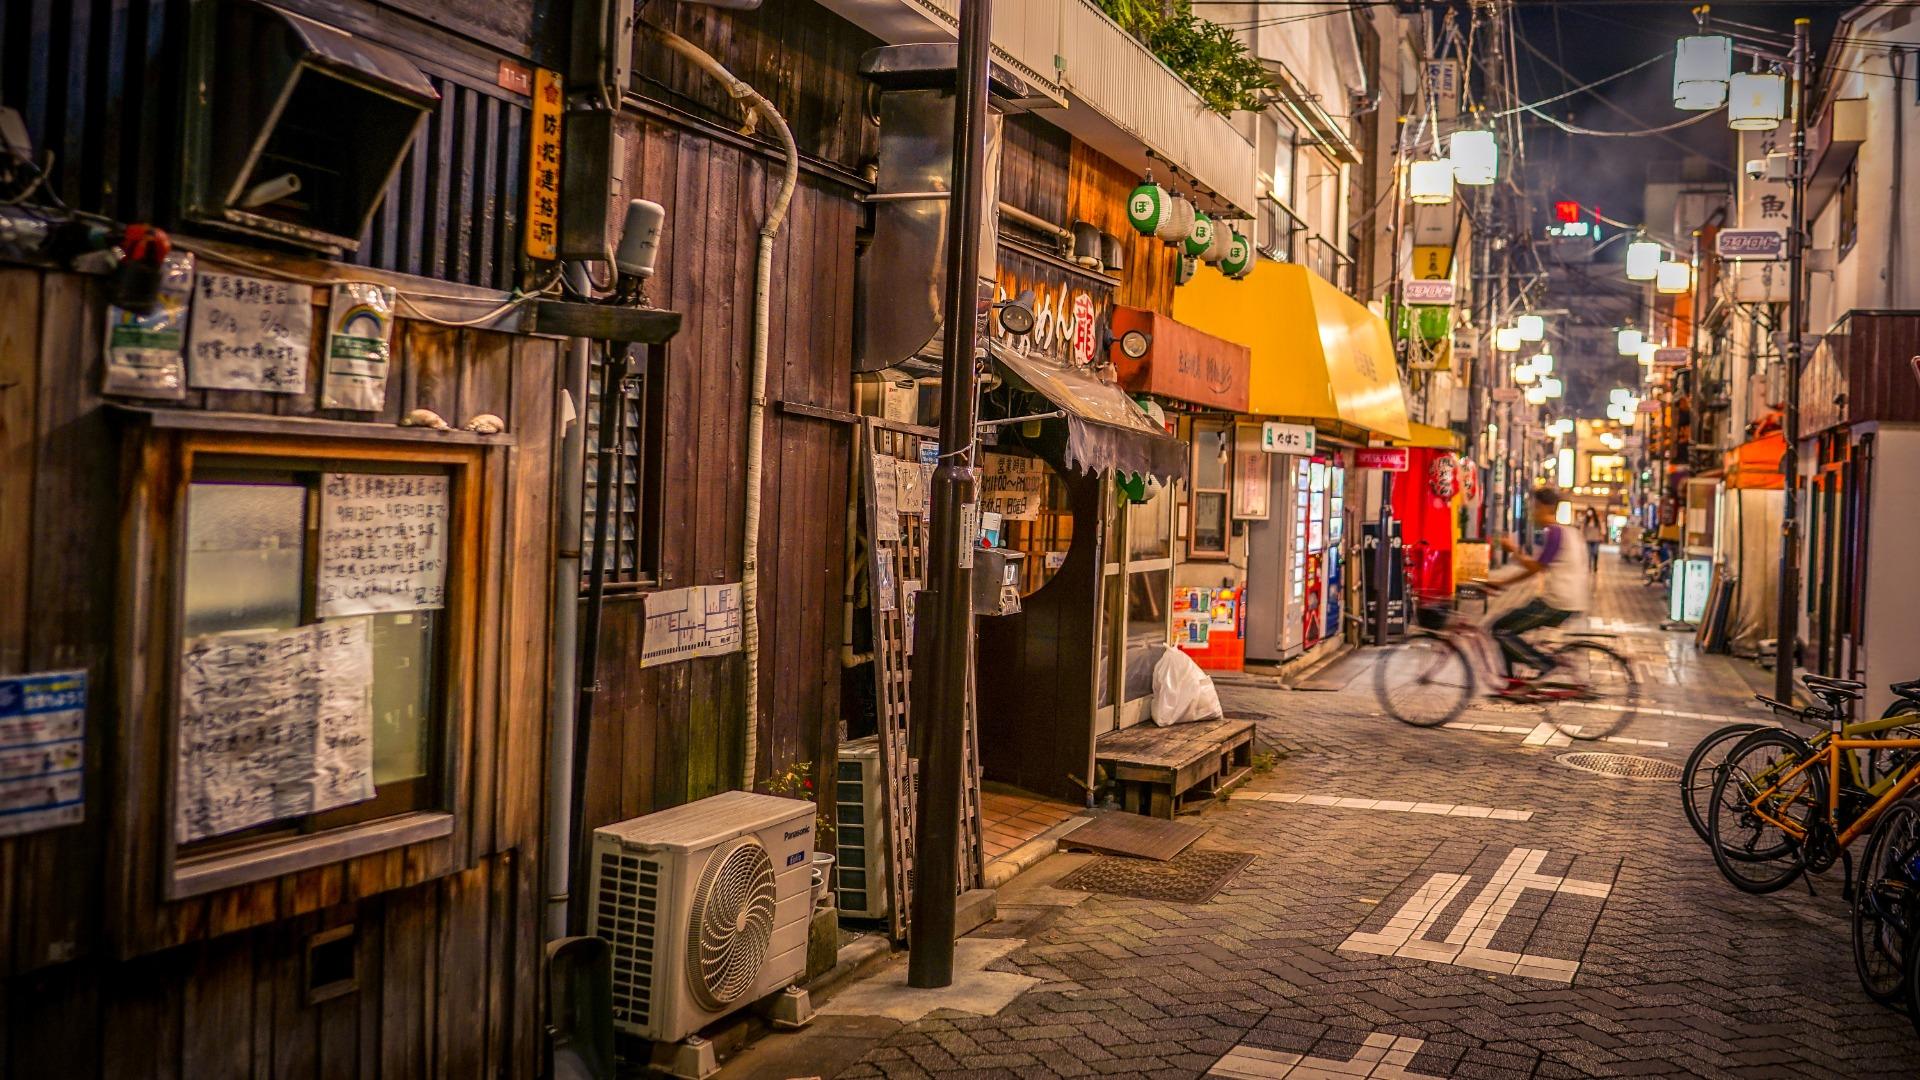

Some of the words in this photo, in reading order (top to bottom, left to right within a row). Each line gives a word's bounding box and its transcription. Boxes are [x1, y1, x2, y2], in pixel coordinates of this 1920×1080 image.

[503, 67, 528, 88] 11-1
[1760, 194, 1789, 220] 魚
[1277, 431, 1300, 446] たばこ
[784, 826, 810, 841] Panasonic
[1339, 847, 1616, 984] 止
